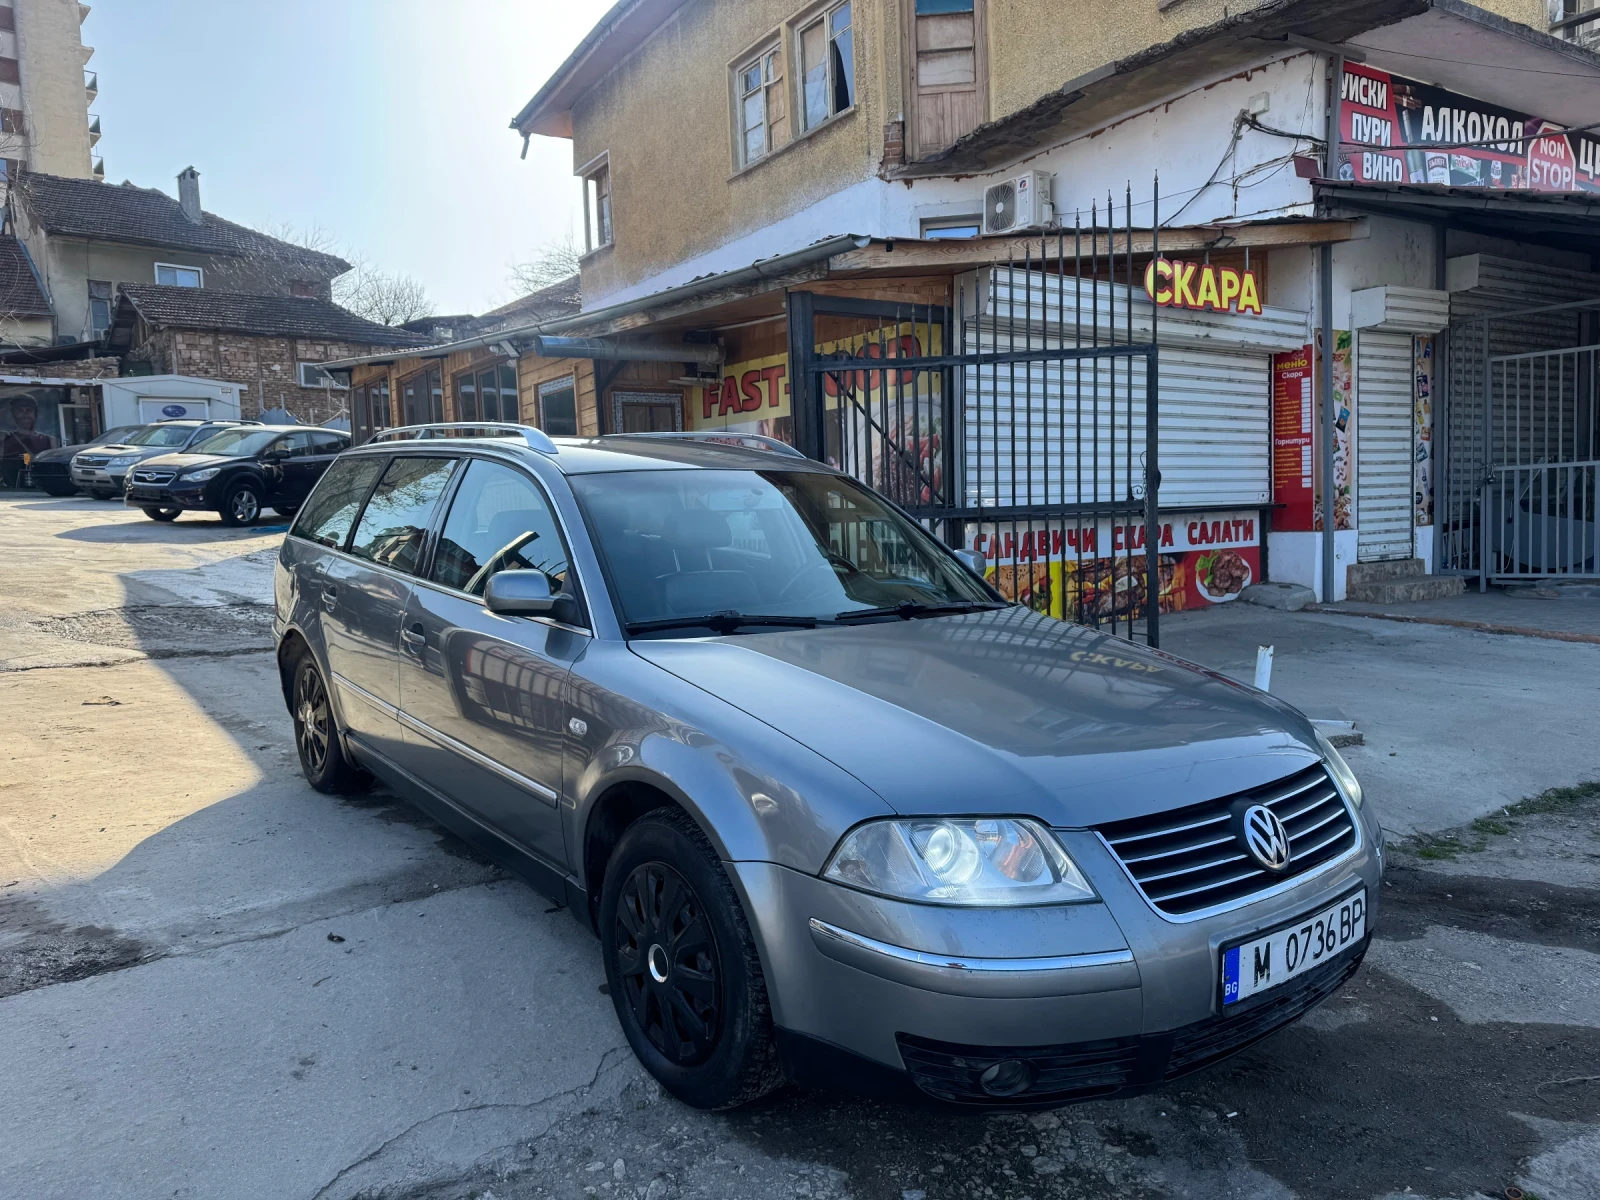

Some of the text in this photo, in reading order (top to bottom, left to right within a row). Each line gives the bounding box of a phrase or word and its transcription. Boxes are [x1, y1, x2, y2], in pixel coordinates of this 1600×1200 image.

[1341, 72, 1388, 110] УИСКИ
[1352, 111, 1392, 147] ПУРИ
[1421, 105, 1524, 155] АЛКОХОЛ
[1540, 138, 1565, 160] NON
[1362, 151, 1404, 183] ВИНО
[1531, 158, 1572, 190] STOP
[1144, 257, 1263, 316] СКАРА
[1281, 371, 1304, 379] Скара
[973, 519, 1254, 563] САНДВИЧИ СКАА САЛАТИ
[1225, 981, 1238, 997] BG
